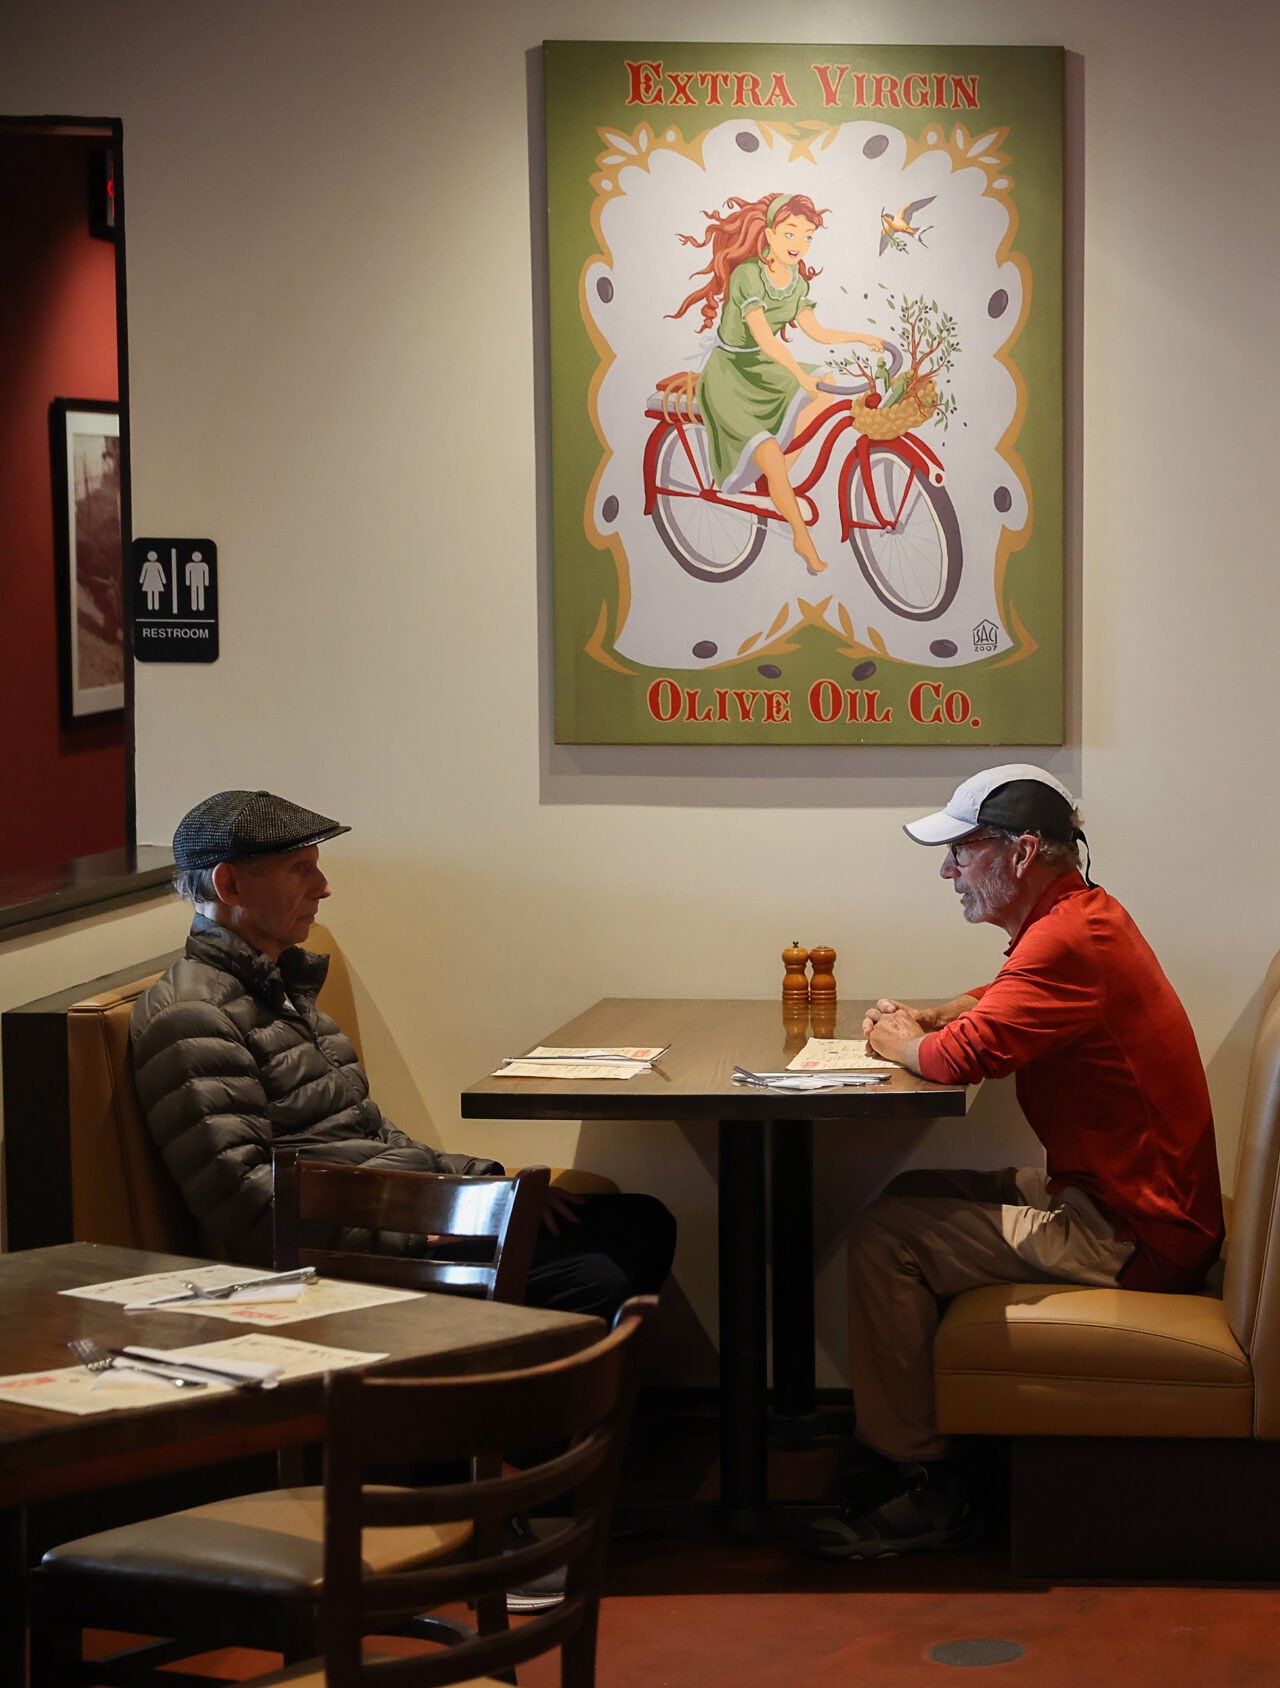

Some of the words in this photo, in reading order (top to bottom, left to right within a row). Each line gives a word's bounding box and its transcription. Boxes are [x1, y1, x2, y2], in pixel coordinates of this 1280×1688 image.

[624, 59, 796, 108] EXTRA
[812, 64, 980, 109] VIRGIN
[142, 628, 209, 638] RESTROOM
[648, 678, 791, 723] OLIVE
[808, 679, 892, 723] OIL
